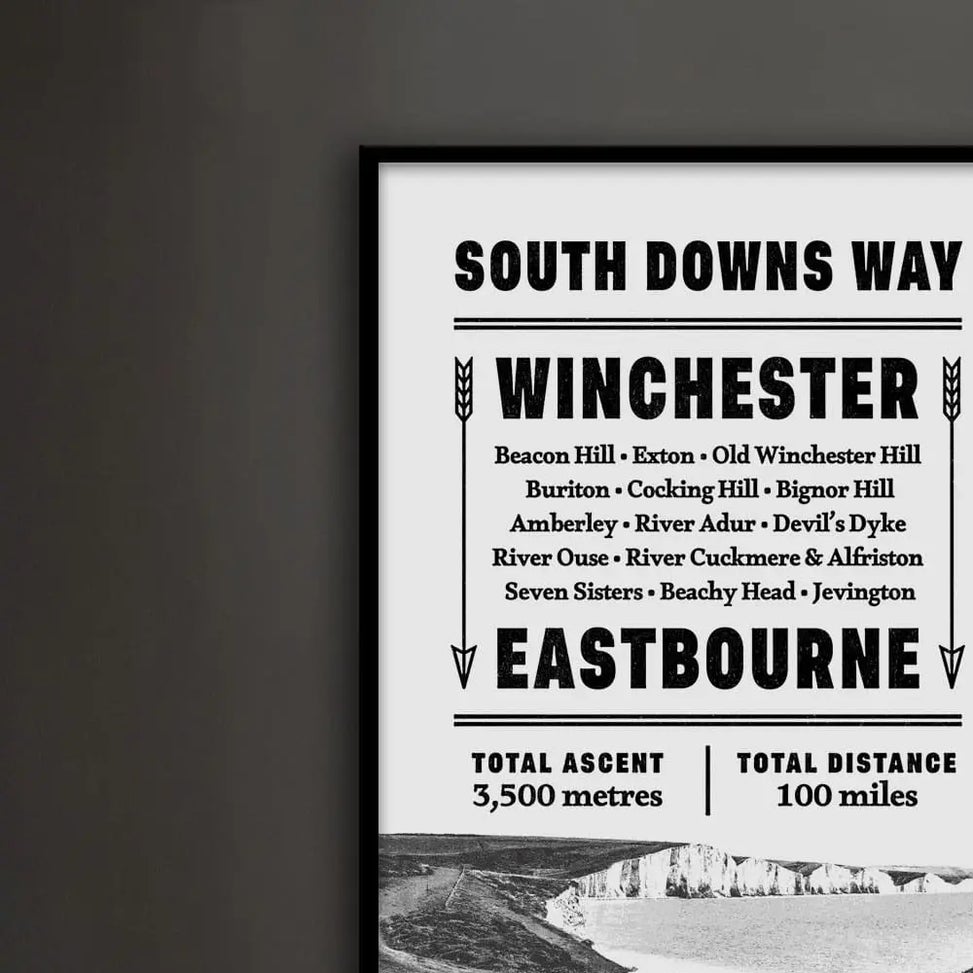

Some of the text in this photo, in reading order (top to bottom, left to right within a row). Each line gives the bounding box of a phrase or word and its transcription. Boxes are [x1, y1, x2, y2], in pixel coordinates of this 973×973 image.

[455, 240, 962, 291] SOUTH DOWNS WAY
[496, 356, 918, 420] WINCHESTER
[495, 444, 922, 464] Beacon Hill Exton Old Winchester Hill
[526, 478, 895, 504] Buriton Cocking Hill Bignor Hill
[509, 511, 906, 538] Amberley River Adur Devil’s Dyke
[492, 546, 924, 566] River Ouse River Cuckmere & Alfriston
[505, 580, 916, 606] Seven Sisters Beachy Head Jevington
[497, 627, 920, 690] EASTBOURNE
[472, 752, 663, 773] TOTAL ASCENT
[737, 752, 956, 773] TOTAL DISTANCE
[473, 784, 663, 813] 3,500 metres
[778, 781, 918, 807] 100 miles
